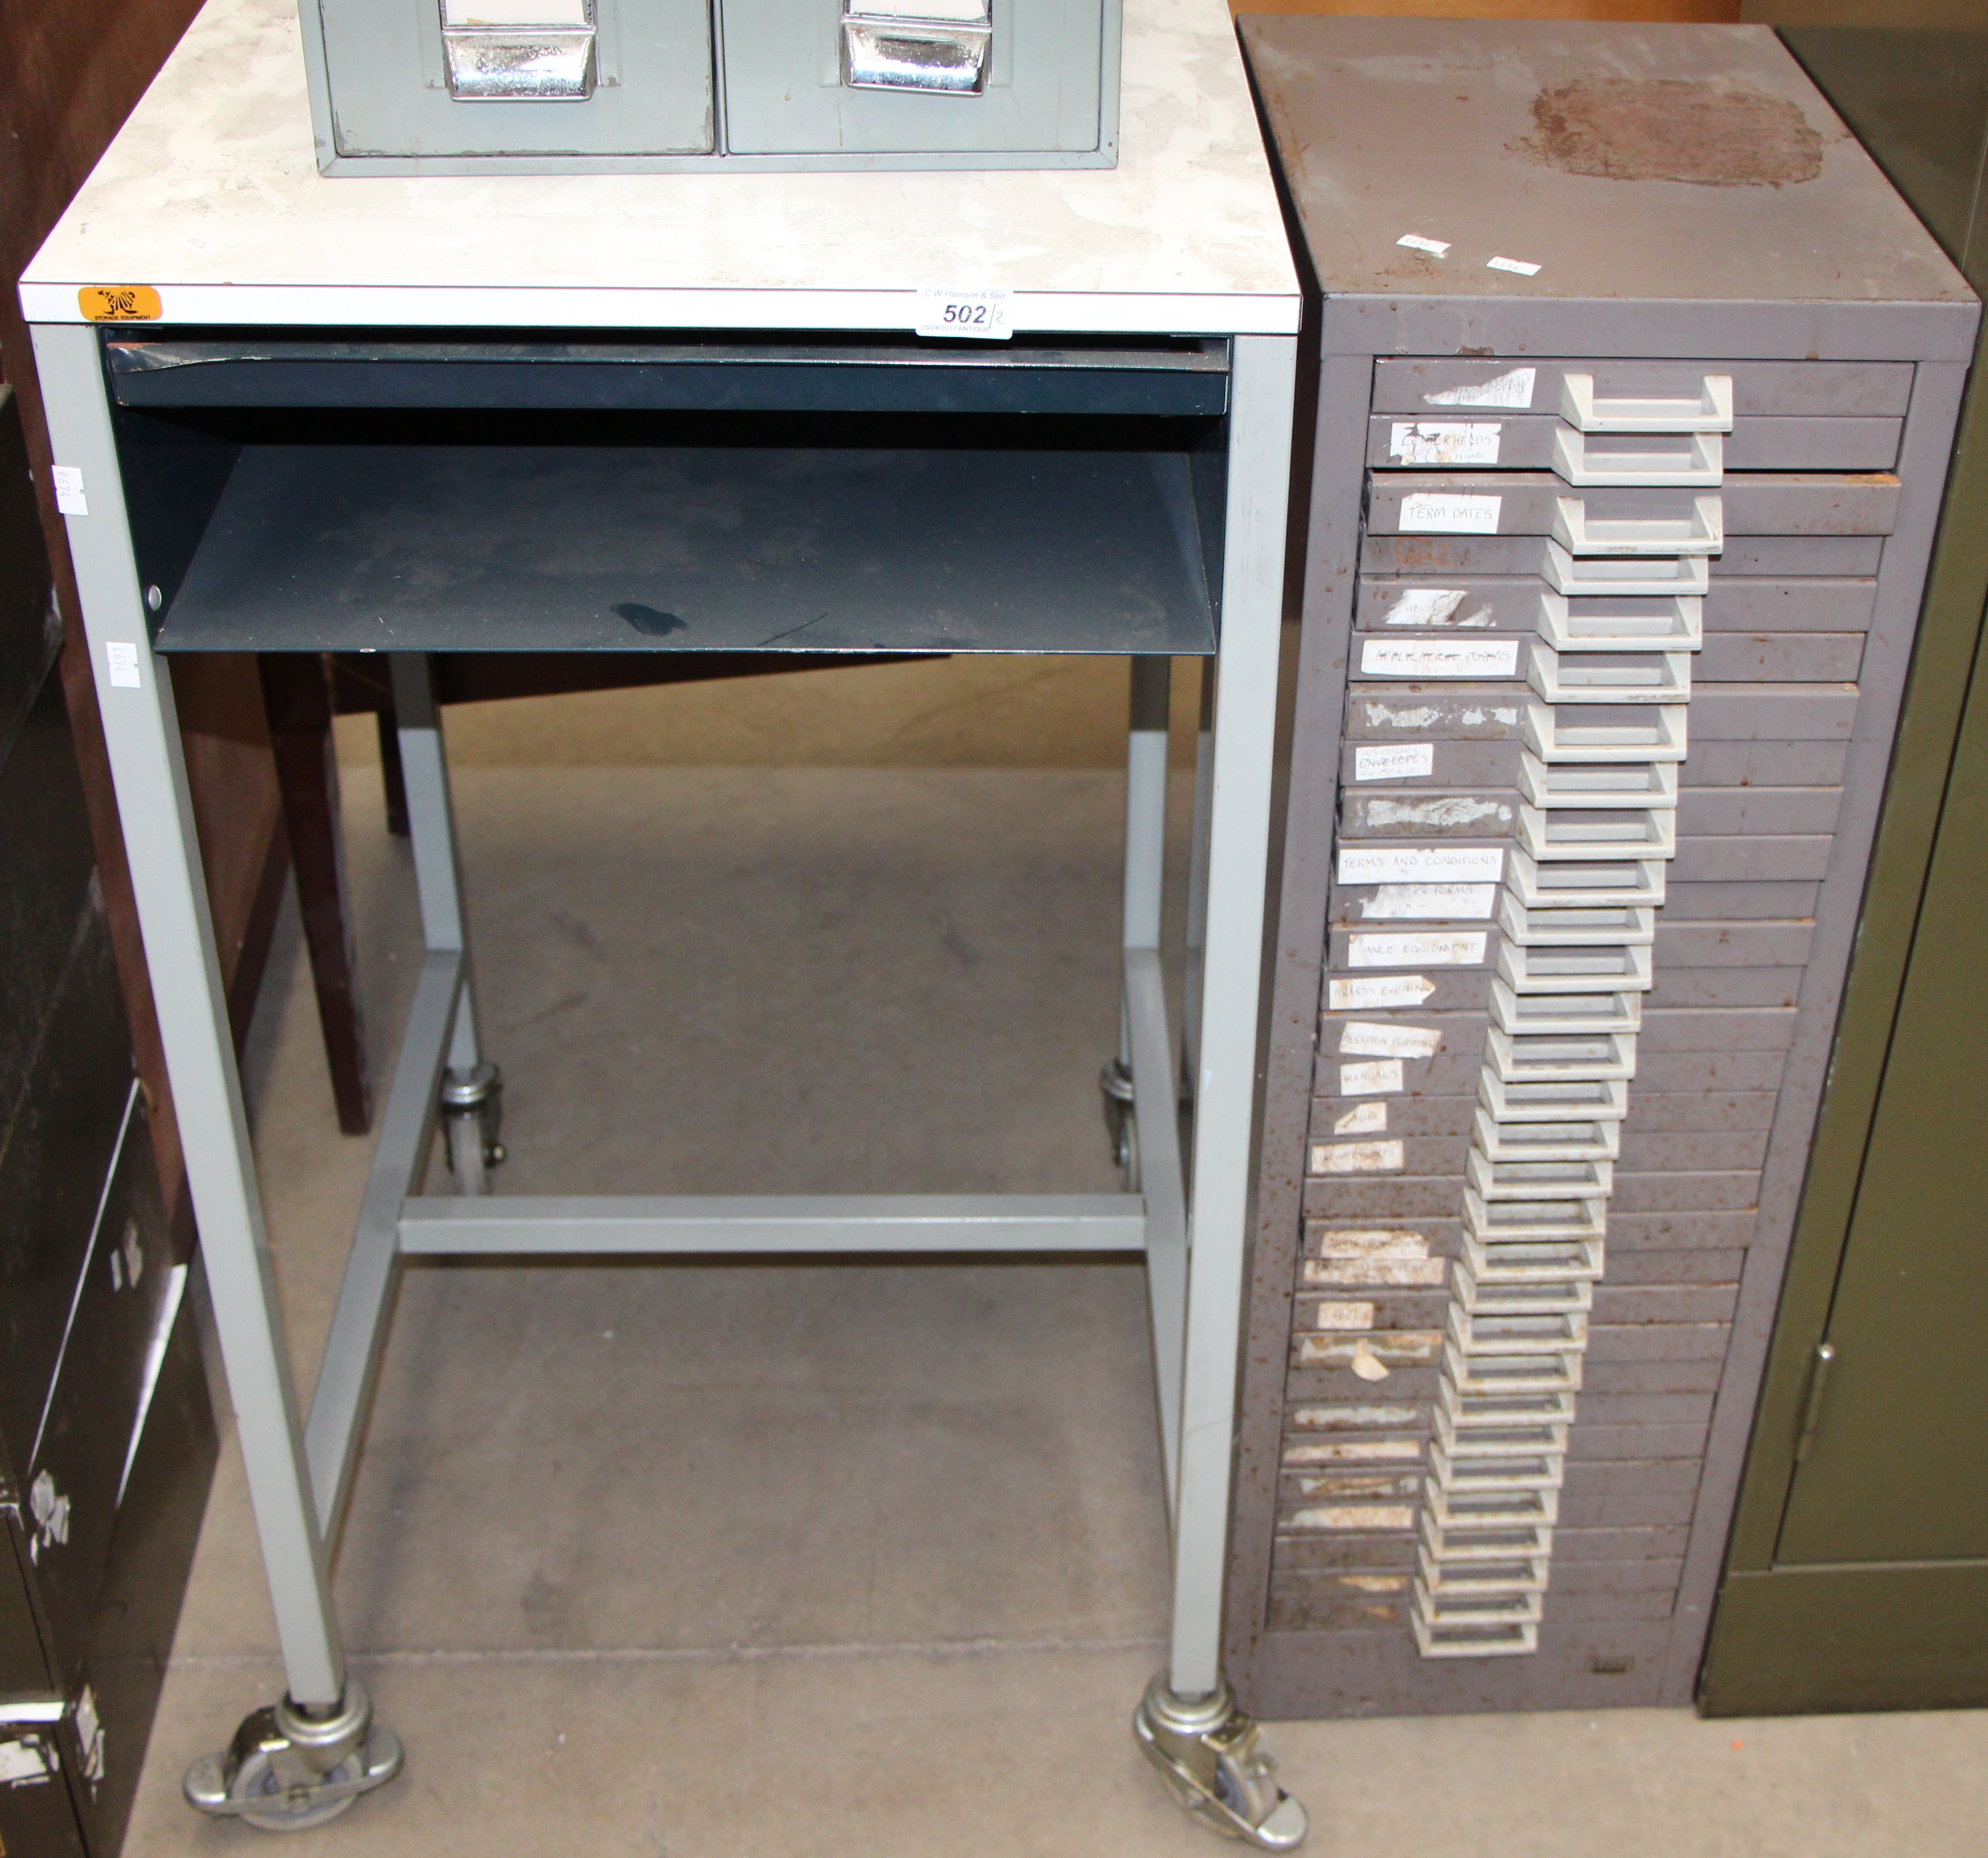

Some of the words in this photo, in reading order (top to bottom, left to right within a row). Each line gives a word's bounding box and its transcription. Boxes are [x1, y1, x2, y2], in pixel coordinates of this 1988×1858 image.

[1408, 505, 1446, 521] TERM
[1452, 507, 1493, 521] DATES
[1358, 754, 1429, 769] ENVELOPES
[1343, 856, 1384, 870] TERMS
[1392, 857, 1418, 867] AND
[1425, 855, 1497, 866] CONDITIONS
[1403, 942, 1478, 955] EQUIPMENT
